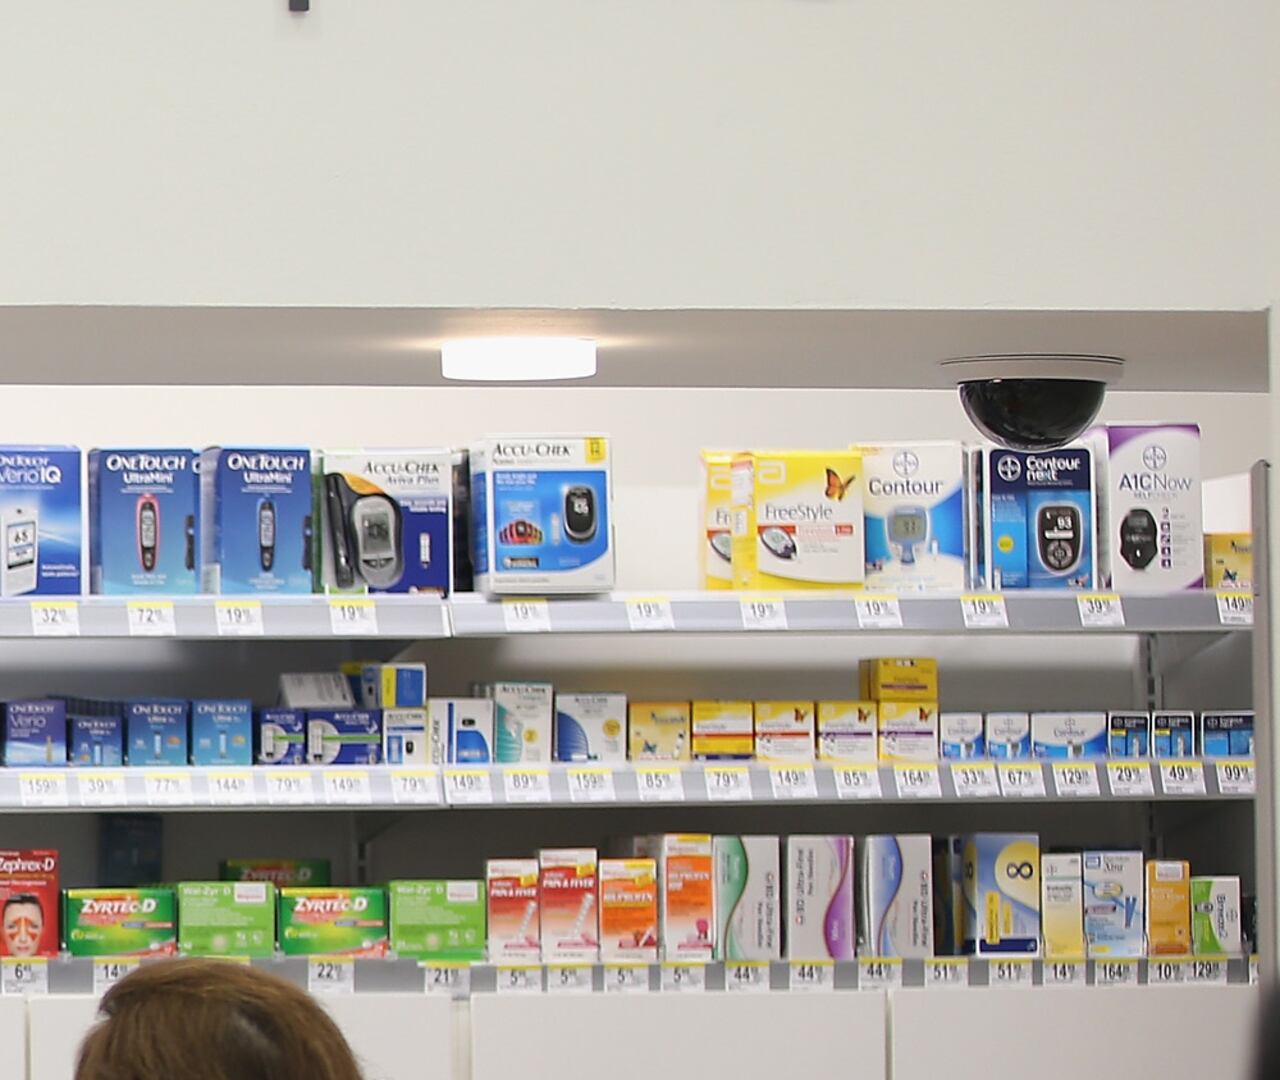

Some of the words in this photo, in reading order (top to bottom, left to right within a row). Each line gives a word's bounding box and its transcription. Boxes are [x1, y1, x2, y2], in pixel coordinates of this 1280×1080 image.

[493, 442, 571, 456] ACCU-CHEK
[106, 454, 186, 471] ONETOUCH
[227, 453, 305, 471] ONETOUCH
[363, 461, 440, 474] ACCU-CHEK
[1026, 456, 1081, 470] Contour
[123, 473, 173, 484] UltraMini
[243, 473, 292, 484] UltraMini
[868, 478, 943, 496] Contour
[765, 503, 833, 523] FreeStyle
[9, 716, 47, 728] Verio
[81, 897, 157, 914] ZYRTEC-D
[293, 896, 369, 912] ZYRTEC-D
